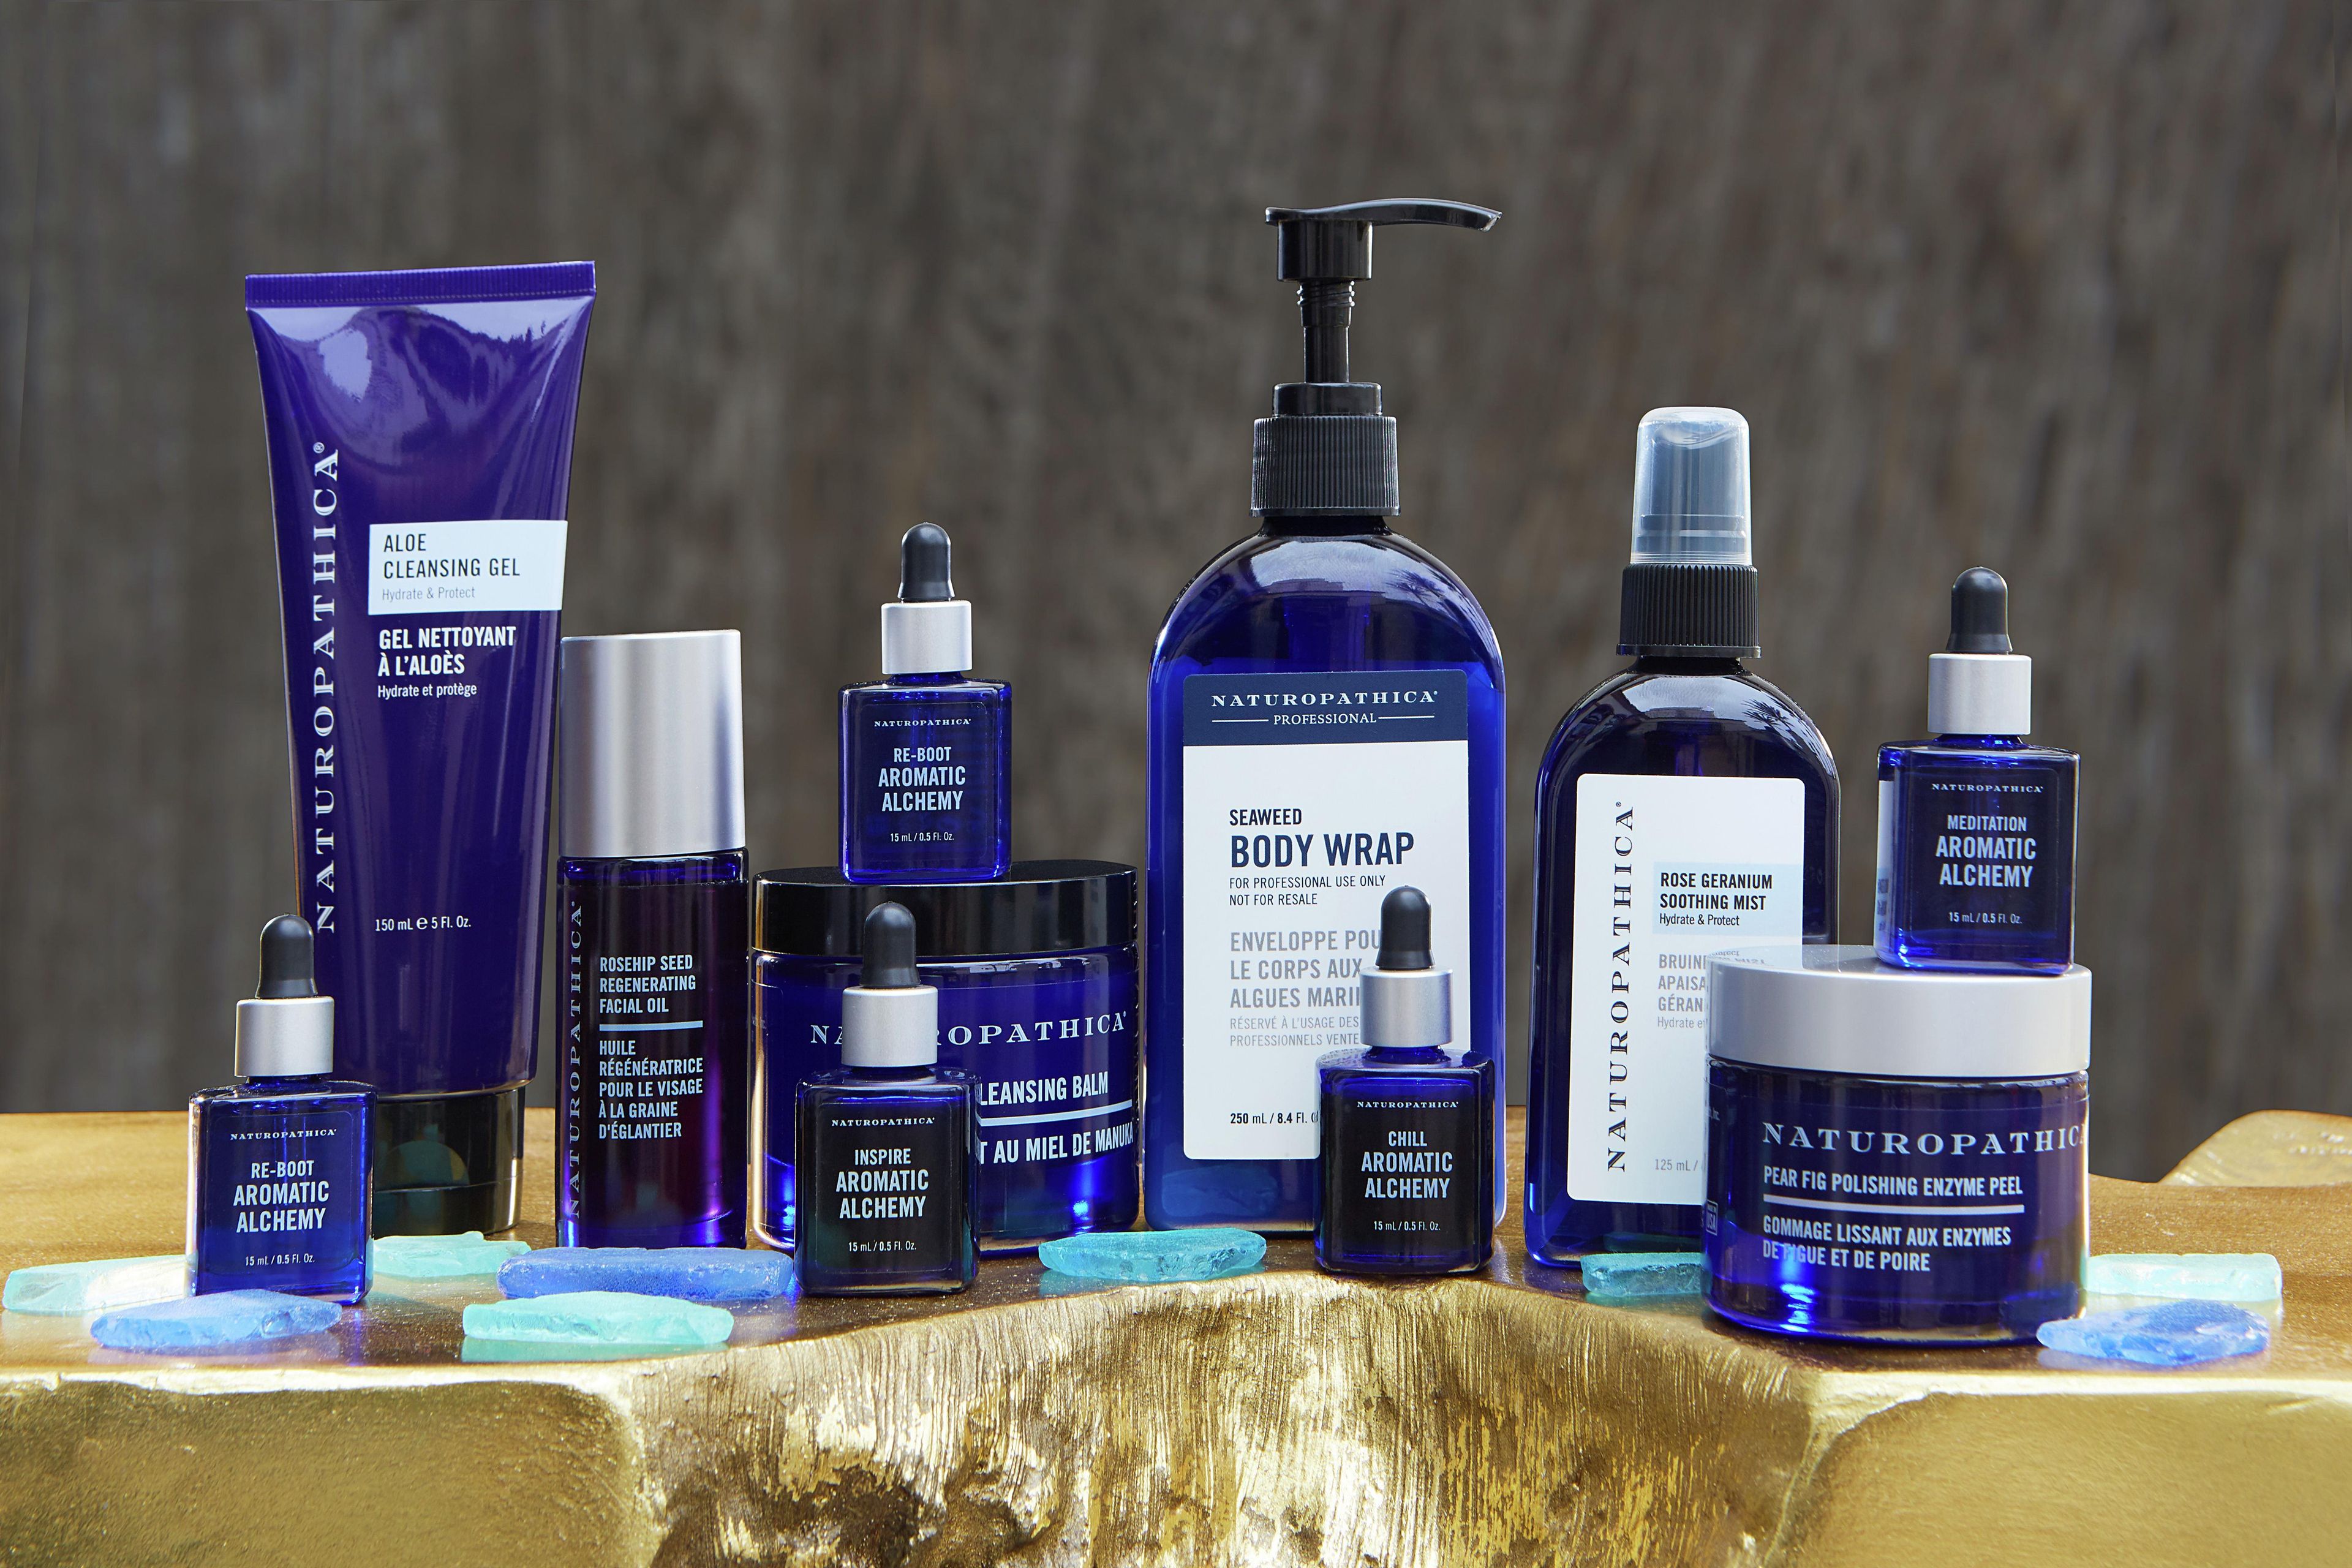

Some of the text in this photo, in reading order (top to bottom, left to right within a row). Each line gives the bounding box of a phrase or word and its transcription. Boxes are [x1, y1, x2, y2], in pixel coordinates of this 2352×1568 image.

[384, 533, 426, 552] ALOE
[384, 558, 520, 579] CLEANSING GEL
[382, 587, 475, 603] Hydrate & Protect
[379, 627, 516, 649] GEL NETTOYANT
[377, 653, 390, 676] À
[378, 683, 477, 700] Hydrate et protège
[1274, 713, 1376, 725] PROFESSIONAL
[894, 747, 951, 762] RE-BOOT
[878, 766, 965, 786] AROMATIC
[881, 791, 963, 812] ALCHEMY
[1229, 808, 1302, 826] SEAWEED
[1947, 815, 2027, 832] MEDITATION
[890, 833, 899, 842] 15
[914, 832, 918, 841] /
[919, 832, 931, 841] 0.5
[944, 832, 954, 840] Oz.
[1231, 832, 1414, 868] BODY WRAP
[1936, 835, 2037, 860] AROMATIC
[1230, 875, 1385, 889] FOR PROFESSIONAL USE ONLY
[1660, 872, 1773, 889] ROSE GERANIUM
[1939, 864, 2034, 888] ALCHEMY
[1230, 893, 1317, 906] NOT FOR RESALE
[1660, 893, 1766, 910] SOOTHING MIST
[375, 919, 394, 931] 150
[398, 918, 413, 930] mL
[431, 917, 438, 929] 5
[441, 916, 453, 929] Fl.
[456, 915, 472, 928] Oz.
[1659, 913, 1740, 925] Hydrate & Protect
[1949, 912, 1959, 922] 15
[1962, 913, 1975, 922] mL
[1976, 913, 1980, 922] /
[1983, 913, 1996, 922] 0.5
[2011, 914, 2022, 924] Oz.
[1231, 930, 1338, 952] ENVELOPPE
[600, 954, 693, 972] ROSEHIP SEED
[1231, 958, 1363, 979] LE CORPS AUX
[600, 975, 696, 993] REGENERATING
[600, 998, 669, 1014] FACIAL OIL
[1230, 988, 1300, 1008] ALGUES
[1230, 1016, 1277, 1030] RÉSERVÉ
[1281, 1016, 1288, 1029] À
[1339, 1016, 1359, 1028] DES
[1657, 1017, 1694, 1030] Hydrate
[599, 1040, 636, 1055] HUILE
[1230, 1033, 1359, 1046] PROFESSIONNELS VENTE
[599, 1057, 703, 1076] RÉGÉNÉRATRICE
[599, 1078, 703, 1098] POUR LE VISAGE
[1072, 1071, 1108, 1099] BALM
[598, 1100, 678, 1118] À LA GRAINE
[1230, 1113, 1248, 1124] 250
[1253, 1113, 1267, 1124] mL
[1270, 1112, 1274, 1124] /
[1277, 1112, 1292, 1123] 8.4
[1296, 1112, 1308, 1123] Fl.
[599, 1121, 682, 1139] D'ÉGLANTIER
[1388, 1131, 1427, 1147] CHILL
[993, 1139, 1019, 1164] AU
[1026, 1136, 1068, 1161] MIEL
[1072, 1132, 1091, 1156] DE
[1095, 1121, 1134, 1152] MANUKA
[855, 1148, 911, 1165] INSPIRE
[1361, 1152, 1453, 1172] AROMATIC
[1655, 1159, 1672, 1170] 125
[1676, 1160, 1691, 1171] mL
[1693, 1160, 1698, 1171] /
[251, 1160, 314, 1178] RE-BOOT
[836, 1169, 929, 1192] AROMATIC
[1365, 1178, 1450, 1198] ALCHEMY
[1764, 1166, 2023, 1196] PEAR FIG POLISHING ENZYME PEEL
[233, 1181, 330, 1206] AROMATIC
[839, 1196, 926, 1219] ALCHEMY
[236, 1207, 326, 1233] ALCHEMY
[1374, 1221, 1382, 1230] 15
[1385, 1221, 1396, 1231] mL
[1398, 1221, 1402, 1231] /
[1404, 1221, 1416, 1231] 0.5
[1430, 1221, 1441, 1231] Oz.
[1763, 1215, 2011, 1247] GOMMAGE LISSANT AUX ENZYMES
[848, 1242, 858, 1251] 15
[861, 1242, 872, 1251] mL
[873, 1241, 878, 1251] /
[879, 1242, 891, 1251] 0.5
[905, 1241, 916, 1250] Oz.
[245, 1256, 254, 1266] 15
[257, 1255, 269, 1265] mL
[271, 1255, 276, 1265] /
[277, 1254, 290, 1264] 0.5
[304, 1253, 315, 1263] Oz.
[1763, 1239, 1931, 1272] DE FIGUE ET DE POIRE
